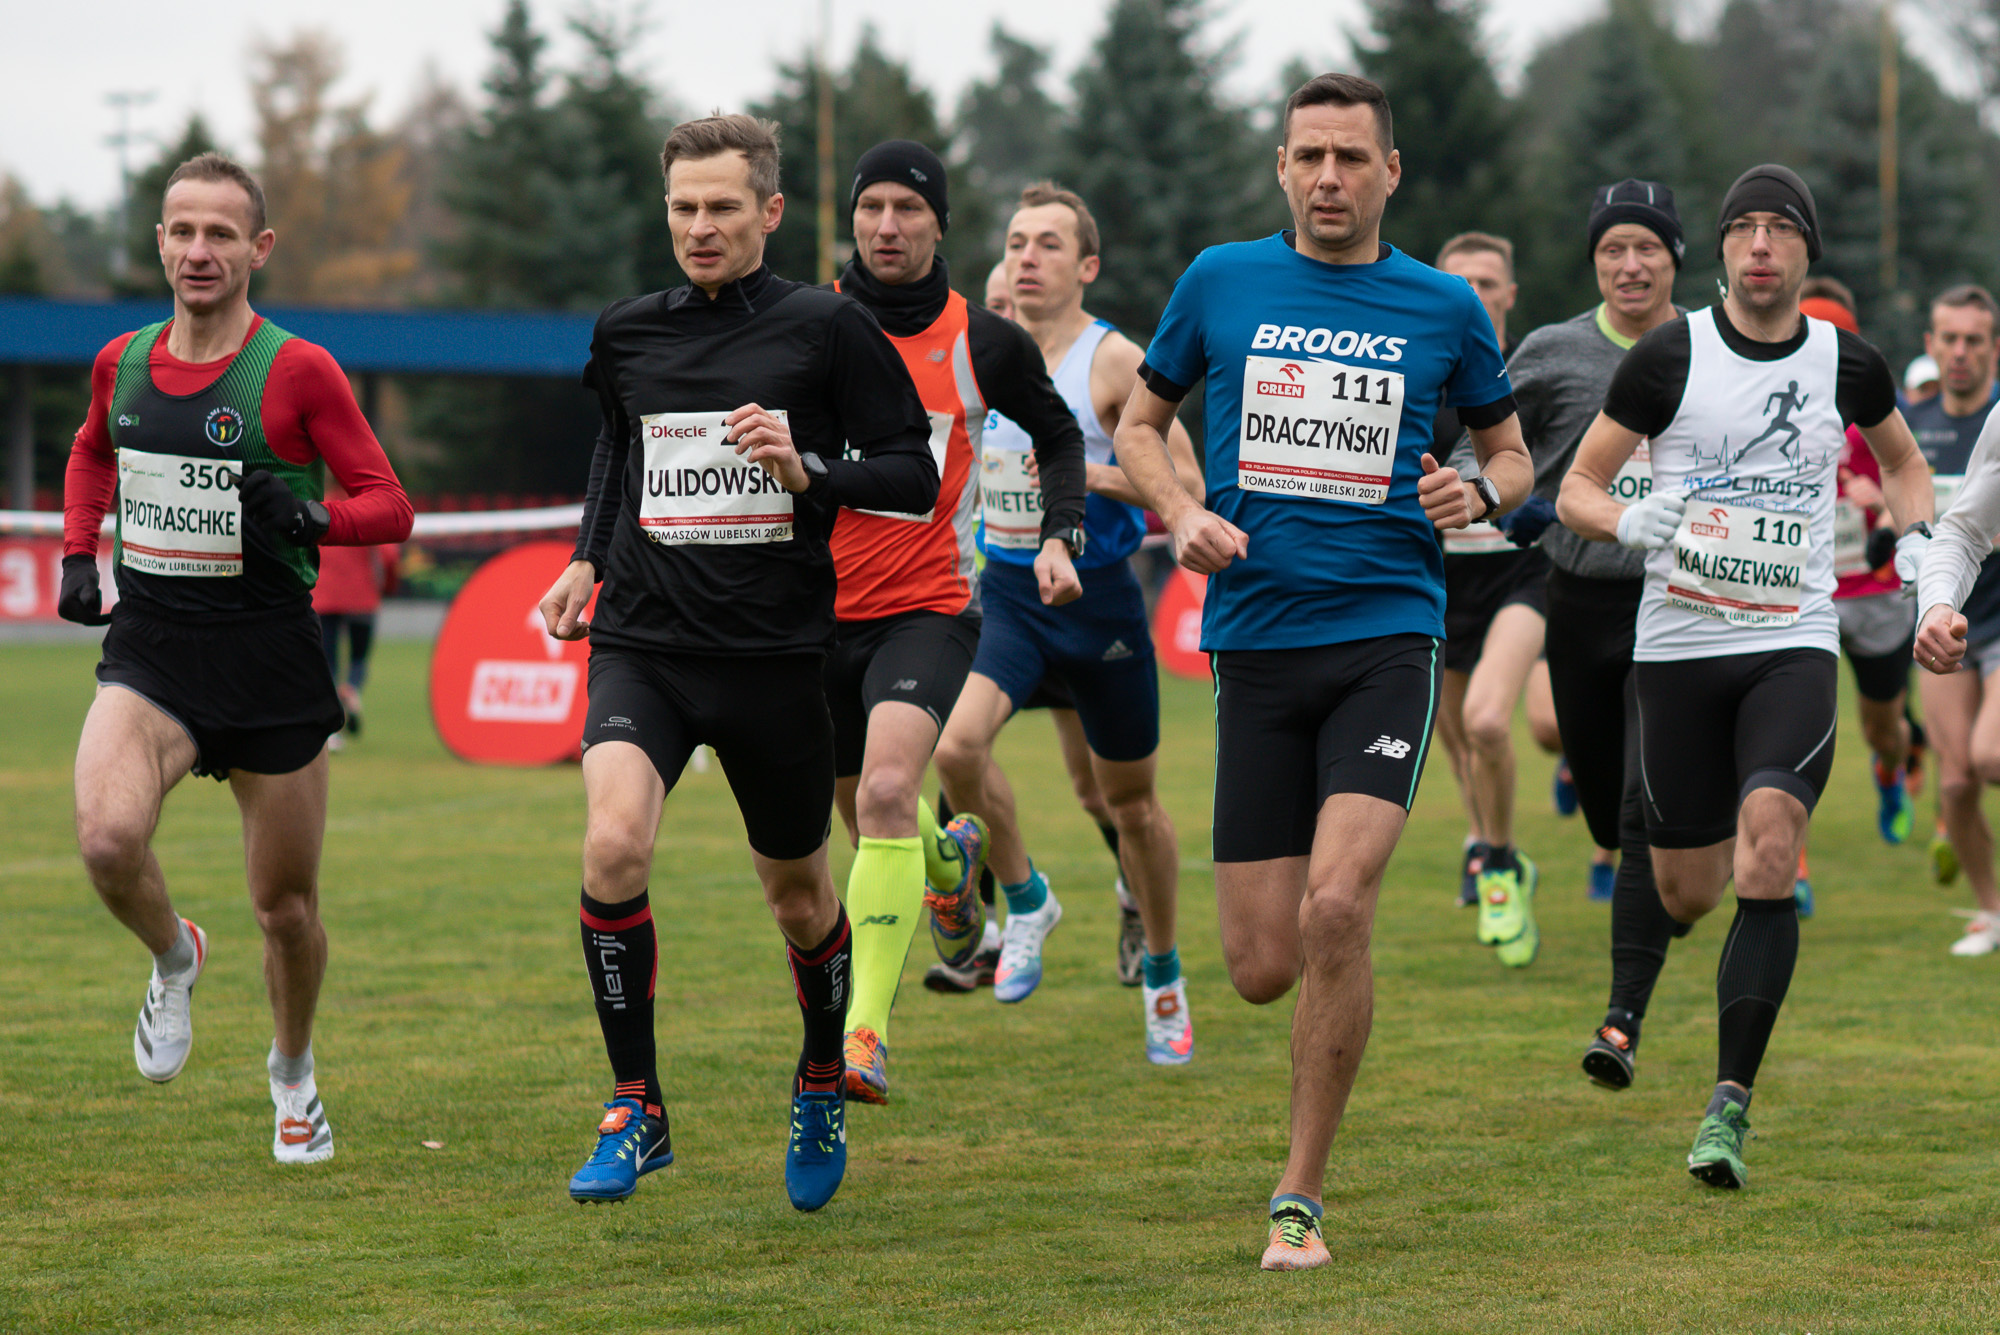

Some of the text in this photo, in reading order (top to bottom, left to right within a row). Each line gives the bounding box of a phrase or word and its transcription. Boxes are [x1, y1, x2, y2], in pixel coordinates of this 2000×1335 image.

[1251, 323, 1408, 362] BROOKS
[1258, 382, 1303, 397] ORLEN
[1332, 372, 1392, 406] 111
[650, 425, 707, 440] Okęcie
[1245, 412, 1390, 456] DRACZYŃSKI
[179, 462, 235, 491] 350
[1244, 475, 1382, 499] TOMASZÓW LUBELSKI 2021
[125, 498, 236, 537] PIOTRASCHKE
[1692, 523, 1727, 538] ORLEN
[714, 528, 761, 539] LUBELSKI
[764, 527, 788, 538] 2021
[1753, 517, 1802, 547] 110
[127, 554, 237, 573] TOMASZÓW LUBELSKI 2021
[1678, 547, 1800, 588] KALISZEWSKI
[1671, 598, 1727, 619] TOMASZÓW
[1729, 611, 1770, 624] LUBELSKI
